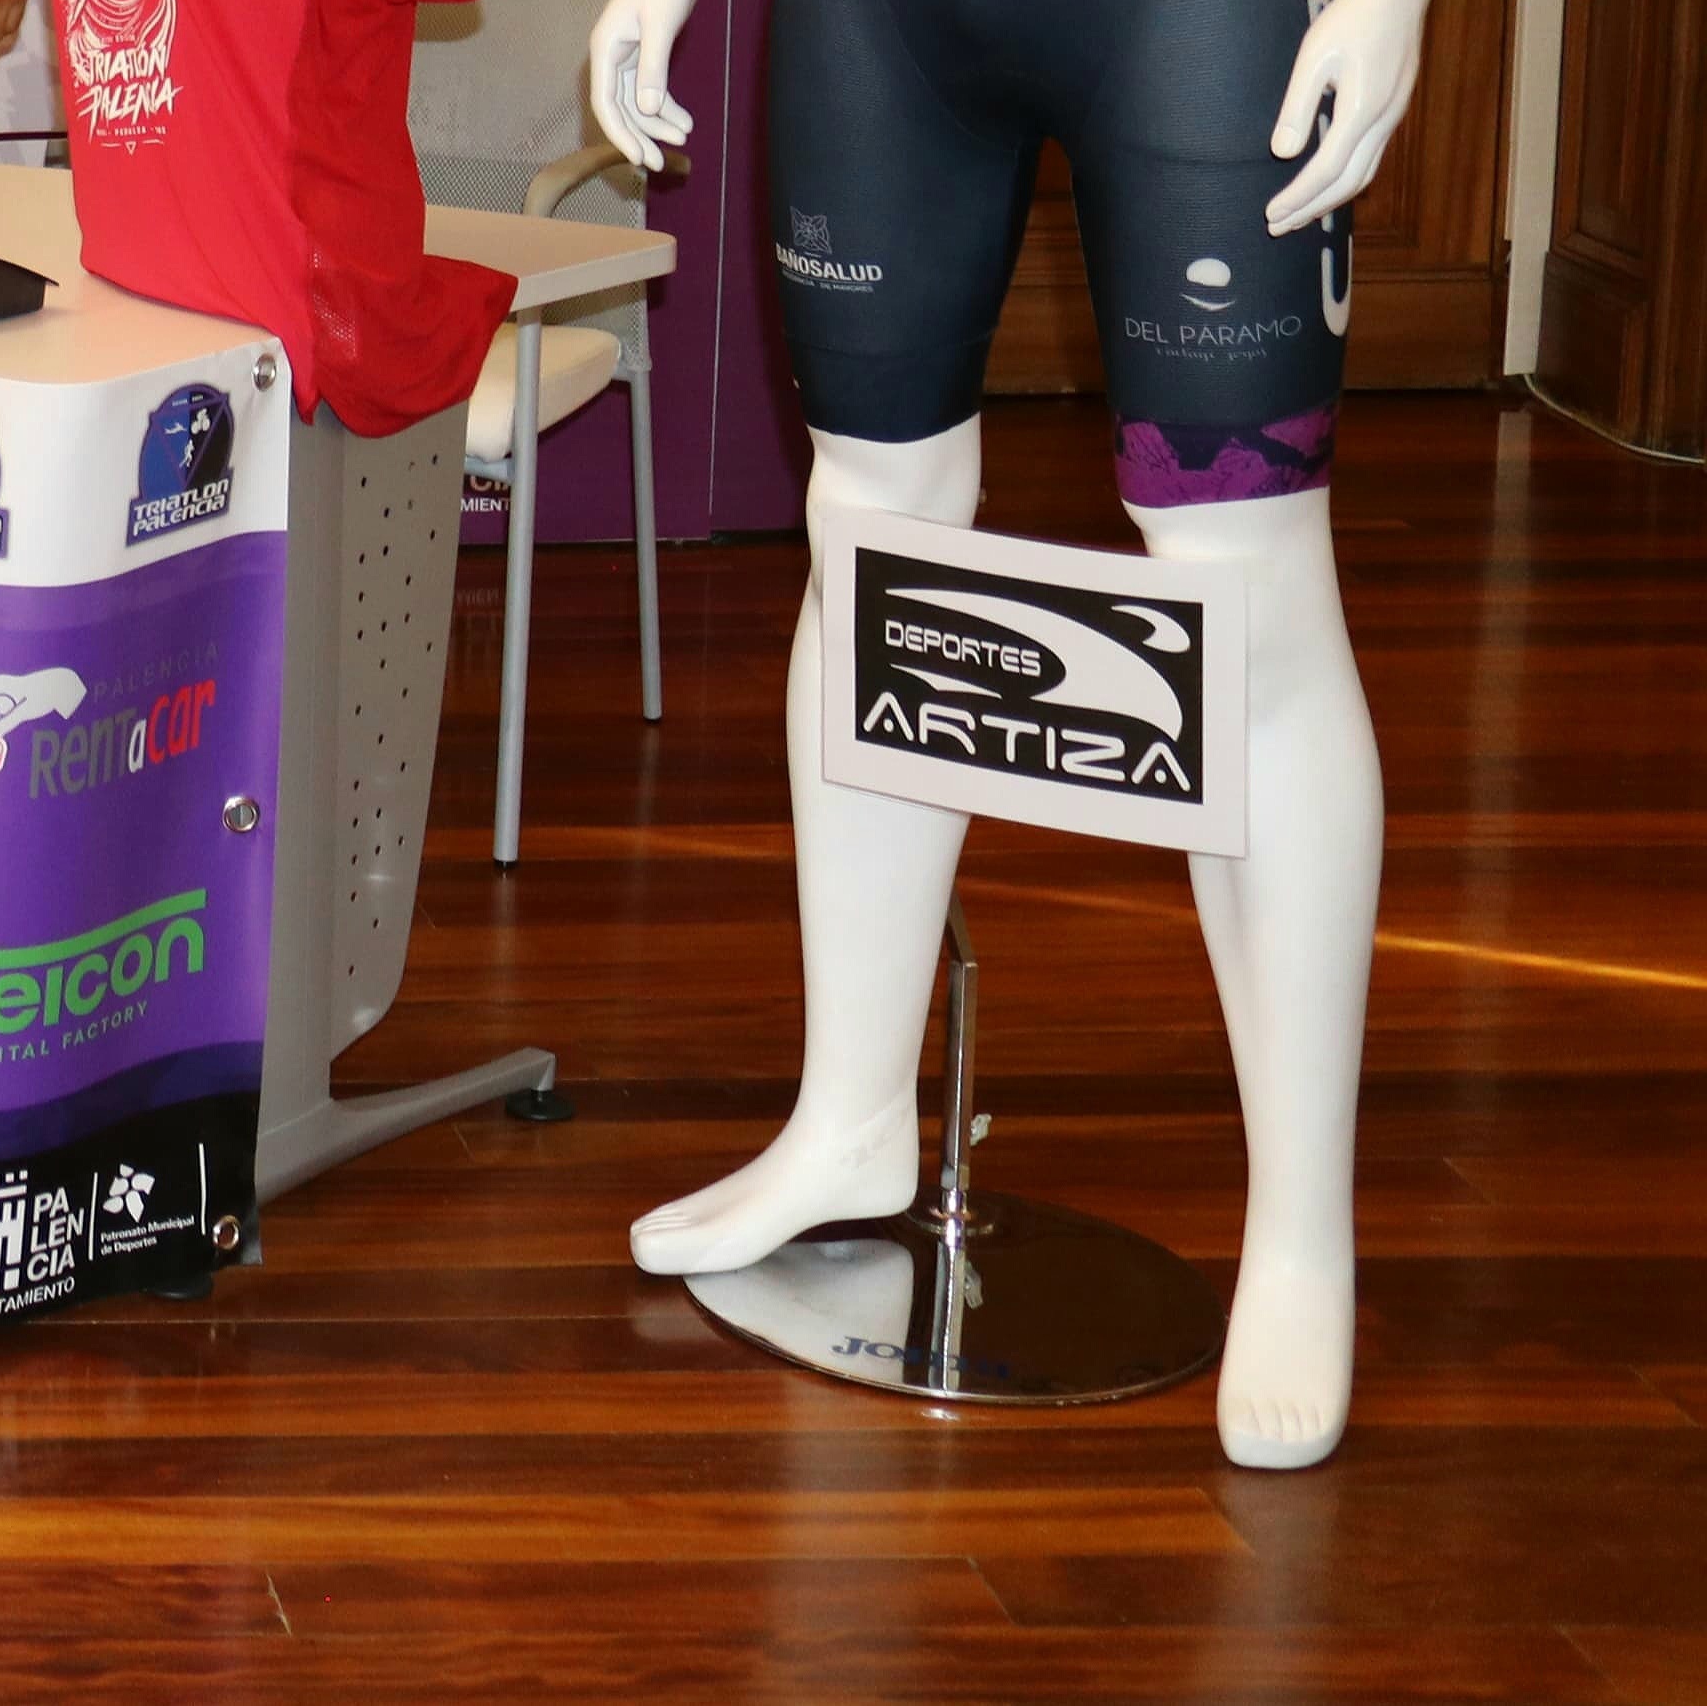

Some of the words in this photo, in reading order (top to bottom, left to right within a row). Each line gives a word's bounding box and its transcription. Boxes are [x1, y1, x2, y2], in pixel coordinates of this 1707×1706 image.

[1125, 317, 1169, 345] DEL
[885, 619, 1041, 678] DEPORTES
[862, 691, 1192, 792] ARTIZA
[62, 1000, 148, 1050] FACTORY
[33, 1186, 70, 1223] PA
[30, 1207, 85, 1254] LEN
[100, 1226, 146, 1243] Patronato
[148, 1214, 195, 1232] Municipal
[100, 1244, 113, 1256] de
[114, 1235, 157, 1255] Deportes
[26, 1244, 75, 1282] CIA
